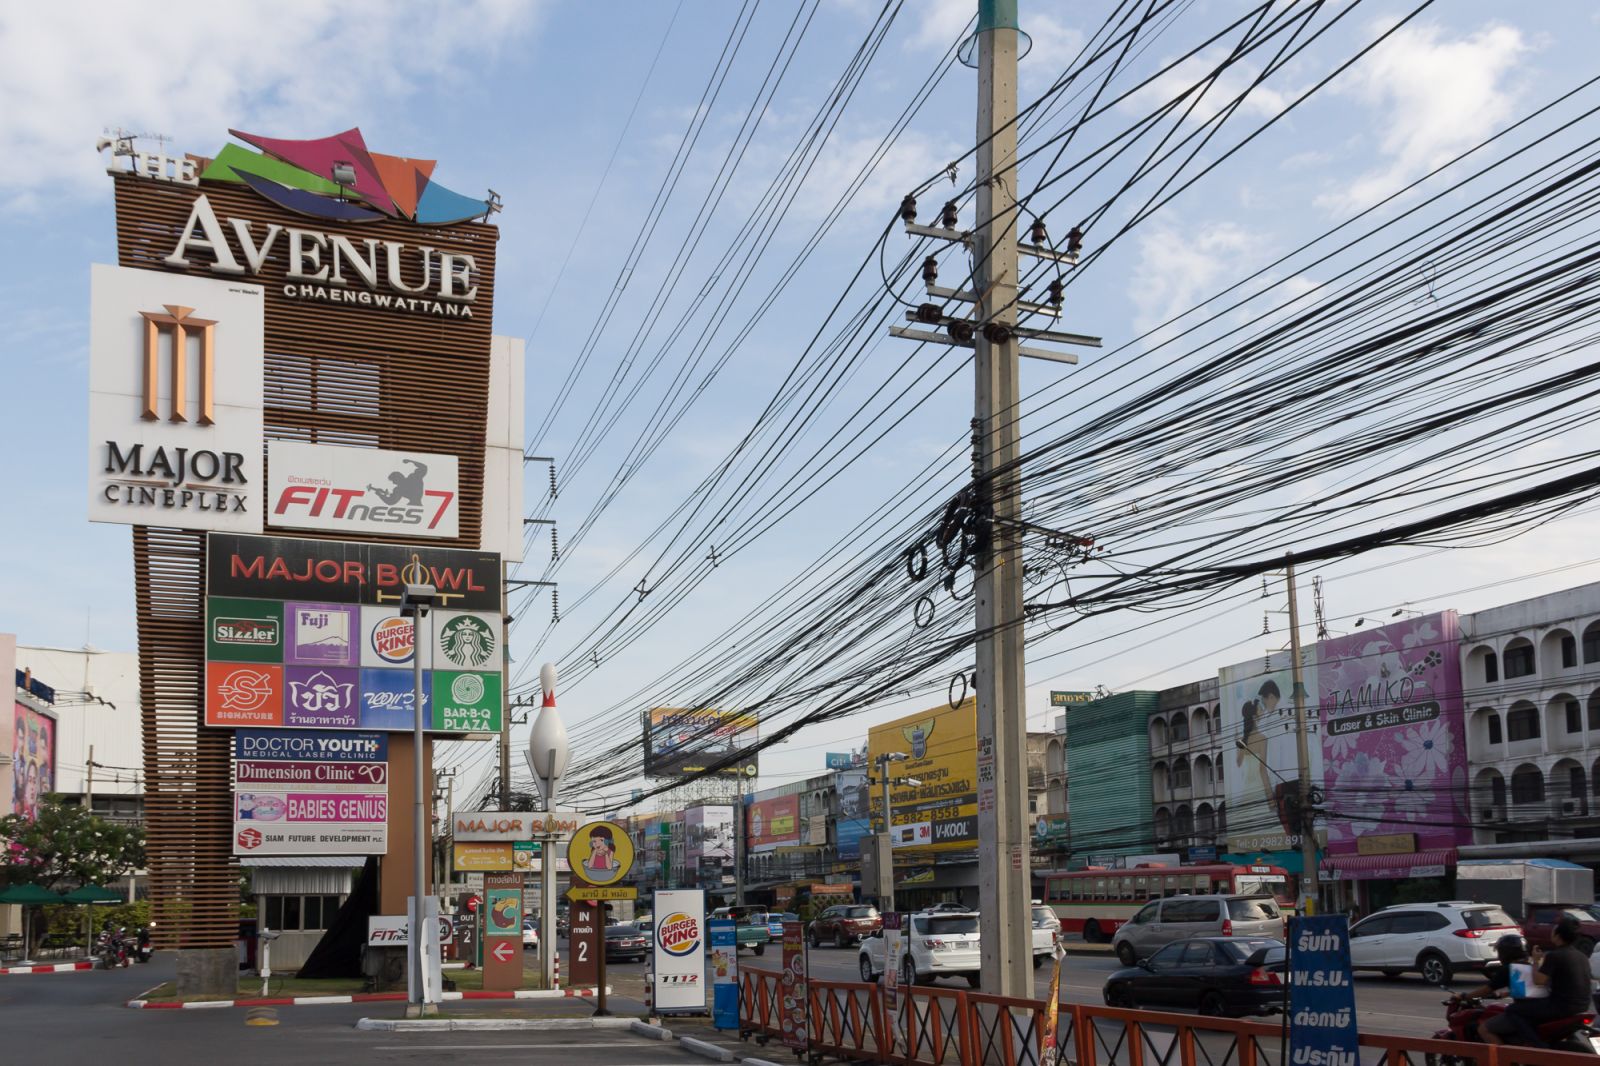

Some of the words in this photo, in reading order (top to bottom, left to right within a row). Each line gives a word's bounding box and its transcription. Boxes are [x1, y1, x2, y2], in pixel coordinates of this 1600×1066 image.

[96, 136, 198, 188] THE
[165, 194, 480, 301] AVENUE
[283, 284, 473, 317] CHAENGWATTANA
[105, 441, 248, 487] MAJOR
[104, 484, 248, 512] CINEPLEX
[424, 490, 454, 529] 7
[231, 554, 367, 585] MAJOR
[377, 555, 486, 592] BOWL
[301, 612, 329, 628] Fuji
[217, 625, 275, 640] Sizzler
[1327, 677, 1414, 715] JAMIKO
[216, 711, 273, 720] SIGNATURE
[290, 712, 355, 725] ร้านอาหารบัว
[1334, 719, 1361, 733] Laser
[1364, 715, 1373, 728] &
[1376, 711, 1400, 726] Skin
[1402, 706, 1433, 721] Clinic
[443, 719, 490, 730] PLAZA
[243, 737, 314, 751] DOCTOR
[317, 739, 377, 752] YOUTH
[243, 750, 292, 758] MEDICAL
[239, 763, 311, 780] Dimension
[315, 765, 355, 780] Clinic
[288, 799, 336, 819] BABIES
[339, 800, 386, 819] GENIUS
[889, 806, 960, 825] 2-982-8558
[456, 818, 523, 833] MAJOR
[920, 826, 930, 839] 3M
[936, 822, 969, 839] V-KOOL
[320, 835, 371, 843] DEVELOPMENT
[1251, 838, 1258, 848] 0
[1260, 836, 1284, 848] 2982
[579, 912, 590, 922] IN
[661, 919, 697, 936] BURGER
[463, 930, 471, 943] 2
[662, 927, 698, 949] KING
[1297, 928, 1341, 952] รับทำ
[578, 941, 588, 962] 2
[662, 975, 698, 983] 1112
[1293, 970, 1349, 987] พ.ร.บ.
[1293, 1006, 1351, 1028] ต่อภาษี
[1292, 1045, 1356, 1066] ประกัน
